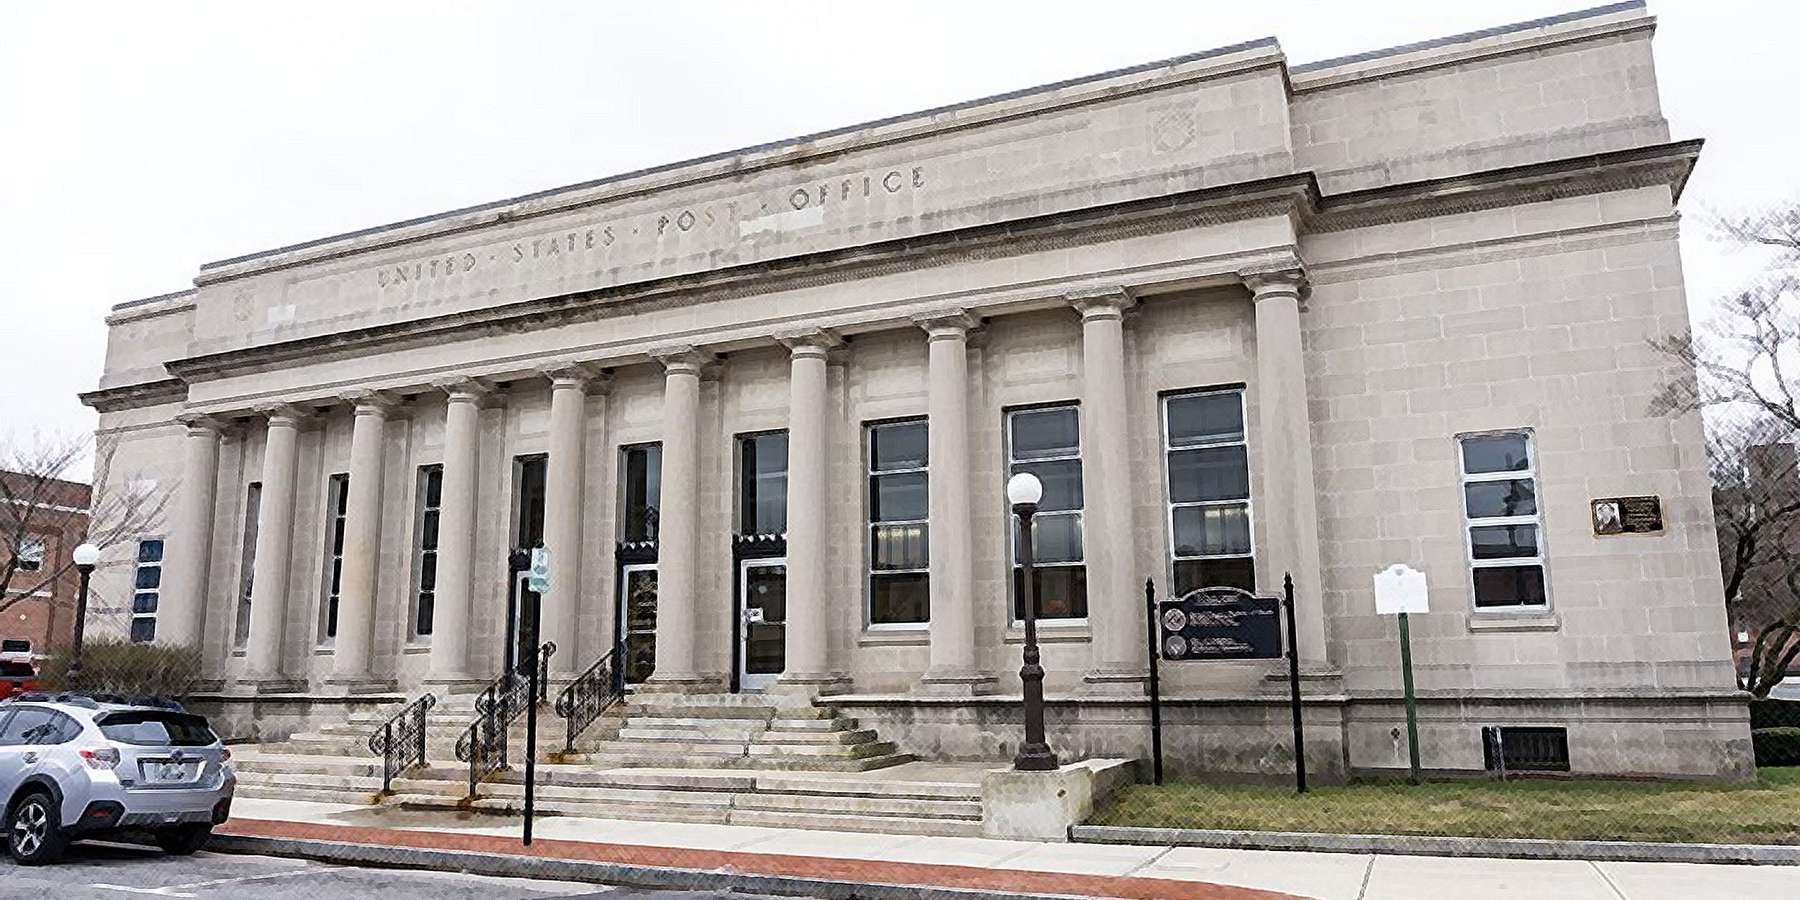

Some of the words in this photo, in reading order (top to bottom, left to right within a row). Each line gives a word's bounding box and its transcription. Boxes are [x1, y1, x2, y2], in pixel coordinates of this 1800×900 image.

[377, 252, 476, 288] UNITED
[513, 226, 615, 263] STATES
[657, 200, 738, 234] POST
[789, 166, 926, 210] OFFICE
